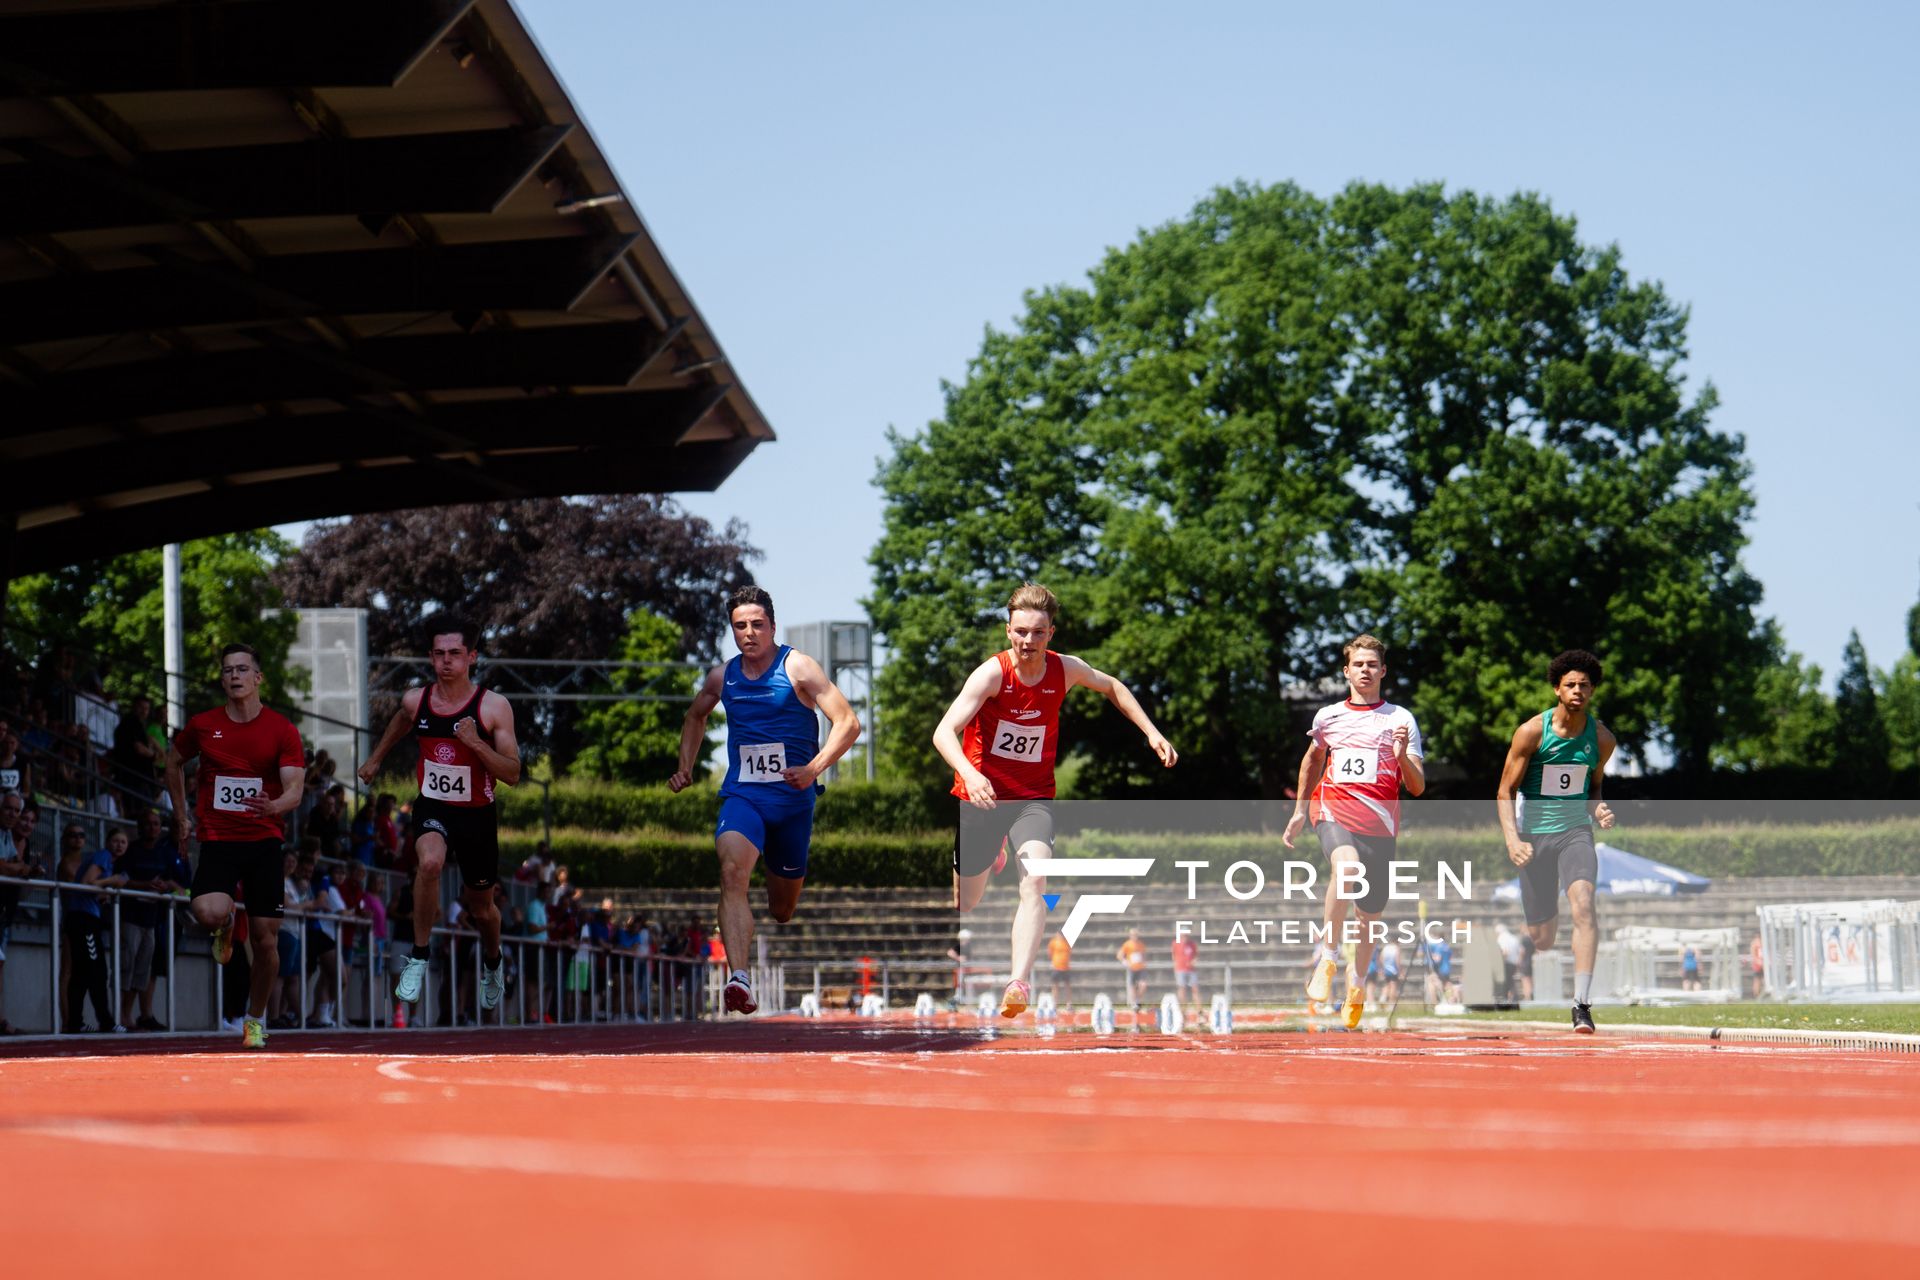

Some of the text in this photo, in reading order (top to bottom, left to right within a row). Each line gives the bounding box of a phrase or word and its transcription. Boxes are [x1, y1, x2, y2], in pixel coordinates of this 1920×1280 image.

[998, 732, 1040, 755] 287
[746, 753, 781, 774] 145
[1341, 758, 1365, 776] 43
[429, 772, 465, 795] 364
[1559, 773, 1571, 790] 9
